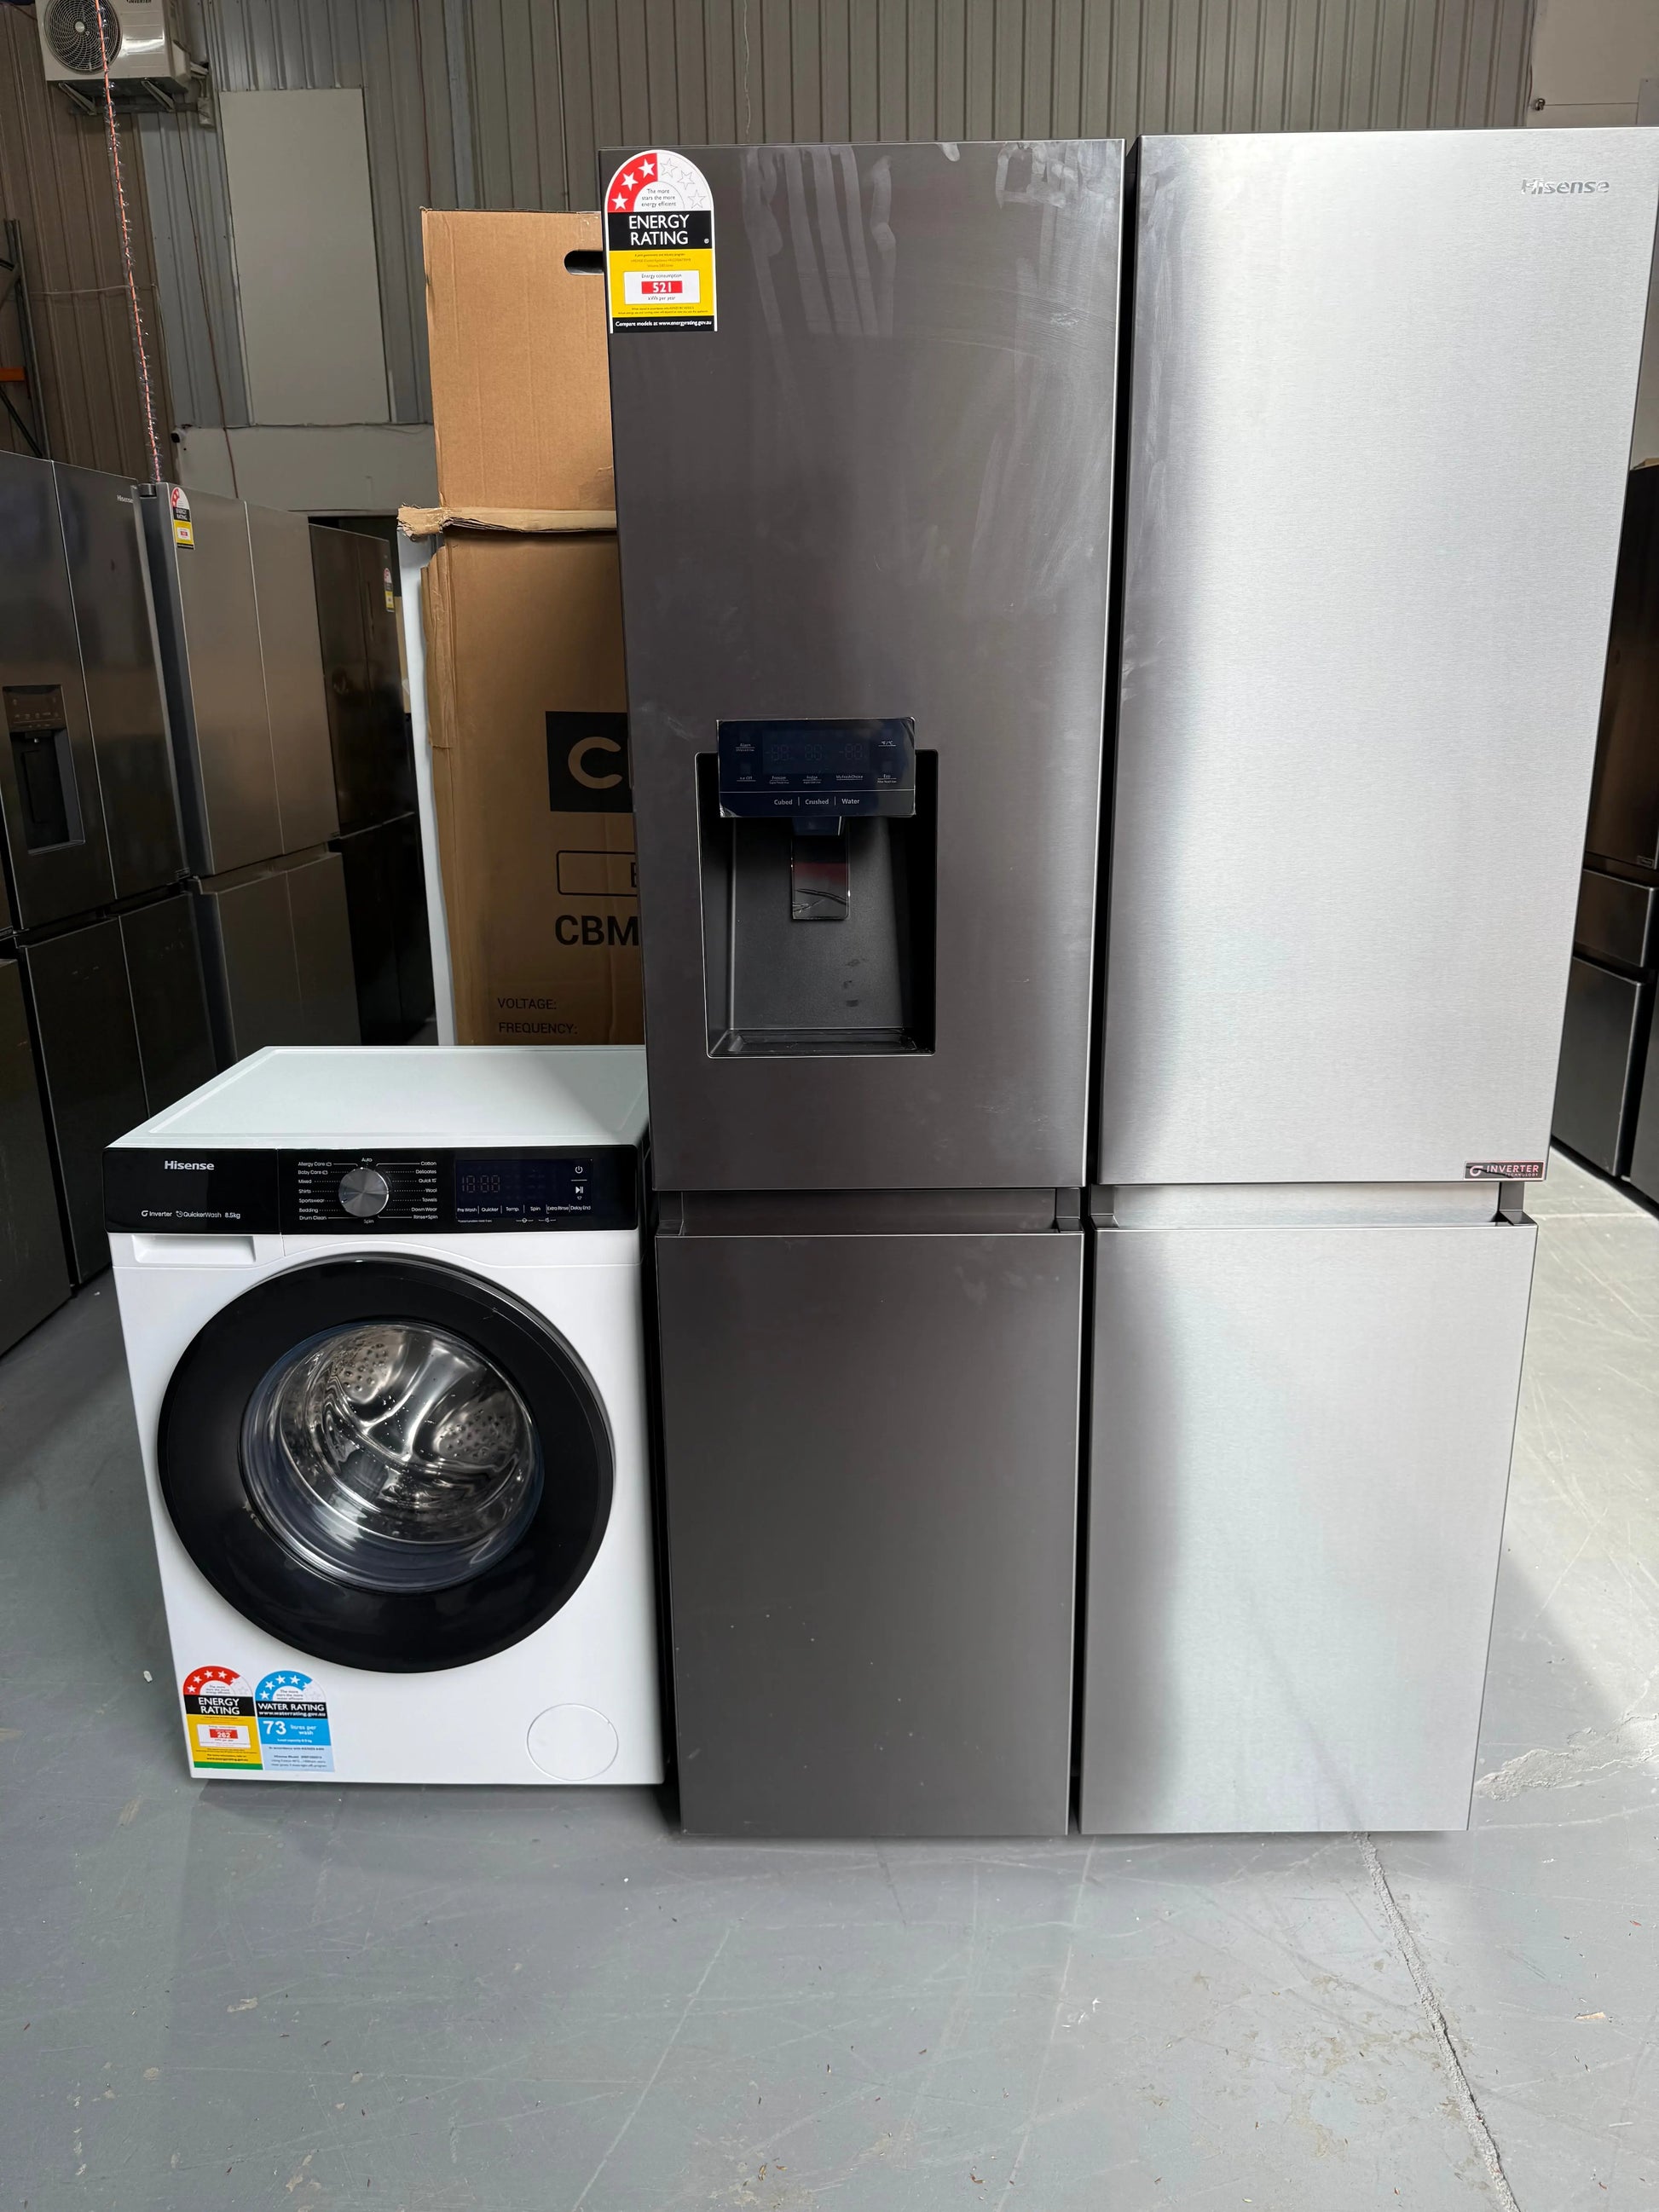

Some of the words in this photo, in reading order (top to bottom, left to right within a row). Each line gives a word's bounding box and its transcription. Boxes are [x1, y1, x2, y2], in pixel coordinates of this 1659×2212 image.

[1522, 179, 1610, 194] Hisense
[628, 214, 690, 229] ENERGY
[630, 231, 689, 245] RATING
[652, 282, 672, 293] 521
[568, 736, 633, 789] C
[555, 915, 639, 946] CBM
[498, 998, 557, 1009] VOLTAGE:
[499, 1022, 578, 1035] FREQUENCY:
[165, 1160, 215, 1170] Hisense
[224, 1211, 240, 1220] 8.5kg
[198, 1697, 240, 1707] ENERGY
[291, 1703, 325, 1712] RATING
[200, 1707, 240, 1715] RATING
[263, 1720, 286, 1735] 73
